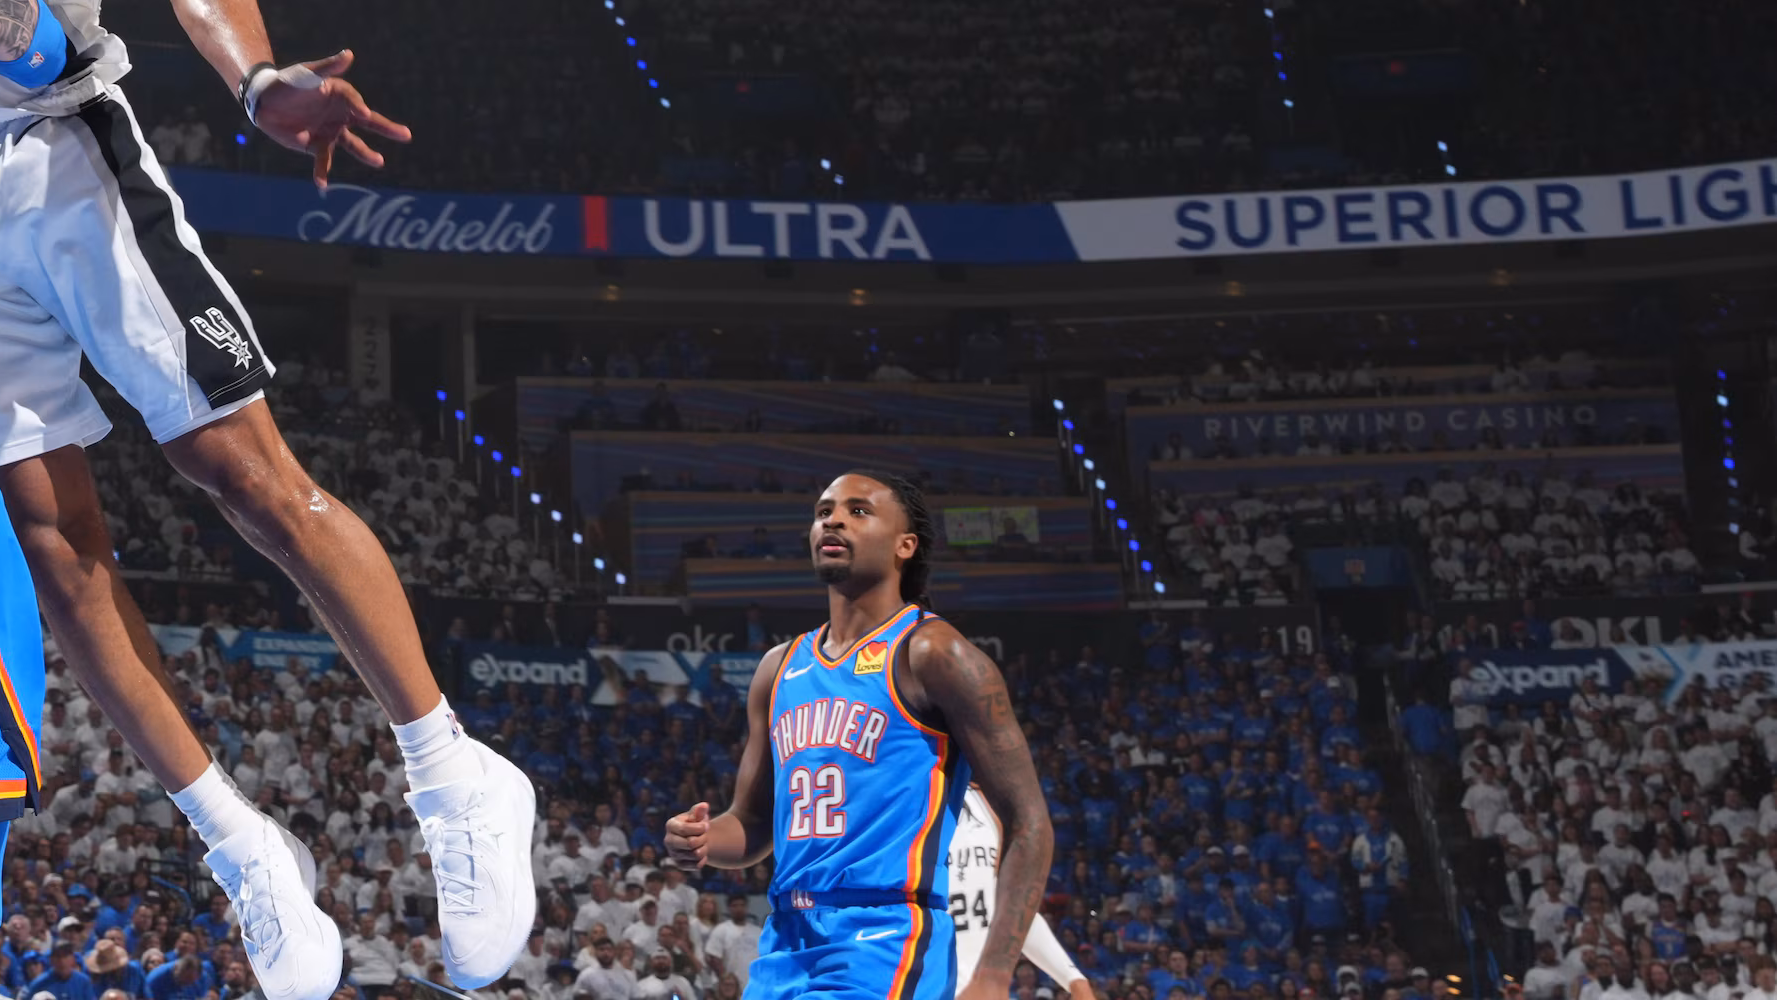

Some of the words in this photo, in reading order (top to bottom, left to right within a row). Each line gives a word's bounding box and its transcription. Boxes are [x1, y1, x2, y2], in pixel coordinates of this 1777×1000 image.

[297, 183, 556, 253] Michelob
[643, 199, 933, 260] ULTRA
[1176, 183, 1585, 250] SUPERIOR
[1204, 410, 1426, 439] RIVERWIND
[1446, 404, 1597, 430] CASINO
[1470, 657, 1611, 694] expand
[772, 697, 889, 768] THUNDER
[787, 763, 848, 841] 22
[950, 889, 990, 930] 24
